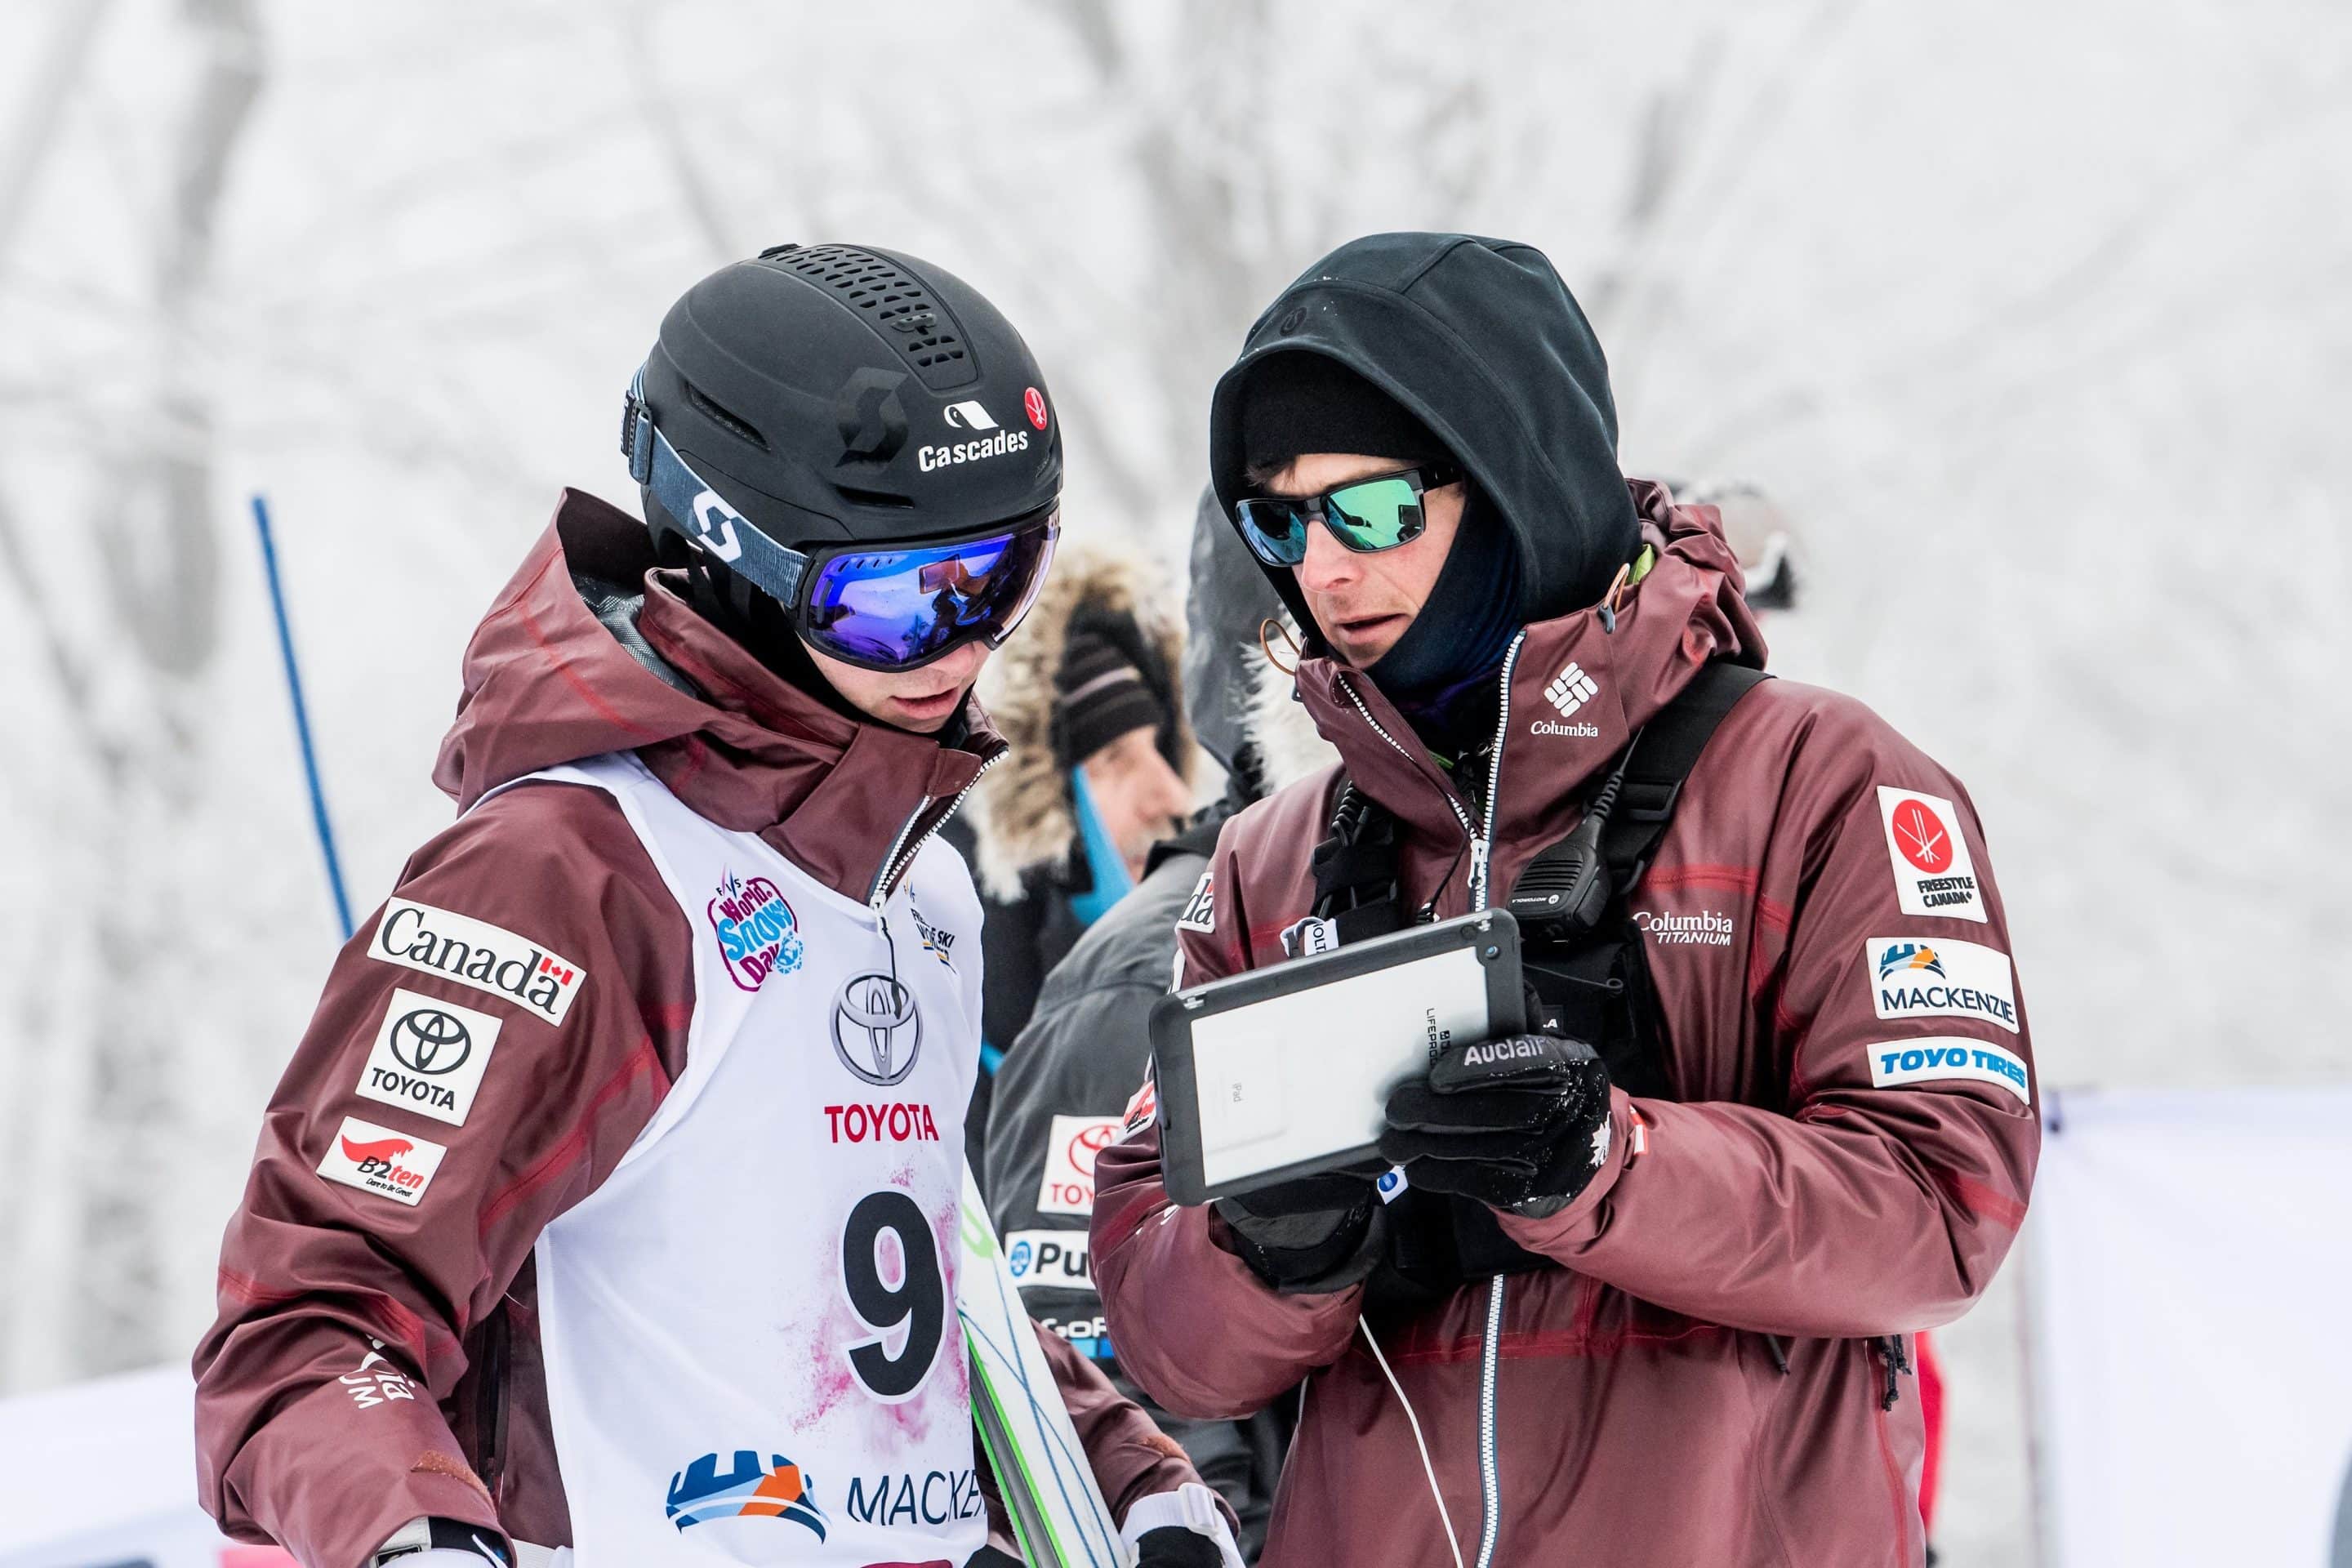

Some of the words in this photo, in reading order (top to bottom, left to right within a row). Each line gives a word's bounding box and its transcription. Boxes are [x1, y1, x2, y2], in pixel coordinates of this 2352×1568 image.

[919, 430, 1028, 472] Cascades
[1530, 720, 1599, 737] Columbia
[716, 879, 742, 896] FIS
[1917, 876, 1975, 893] FREESTYLE
[1922, 891, 1969, 908] CANADA
[719, 882, 769, 925] World
[938, 930, 956, 947] SKI
[1632, 911, 1733, 933] Columbia
[1656, 932, 1731, 946] TITANIUM
[381, 907, 560, 1015] Canada
[1882, 987, 2016, 1024] MACKENZIE
[1463, 1038, 1546, 1066] Auclair
[1881, 1048, 1968, 1074] TOYO
[1971, 1049, 2026, 1089] TIRES
[372, 1067, 455, 1111] TOYOTA
[824, 1102, 939, 1143] TOYOTA
[357, 1156, 425, 1189] B2ten
[1036, 1242, 1087, 1276] Pu
[843, 1192, 944, 1396] 9
